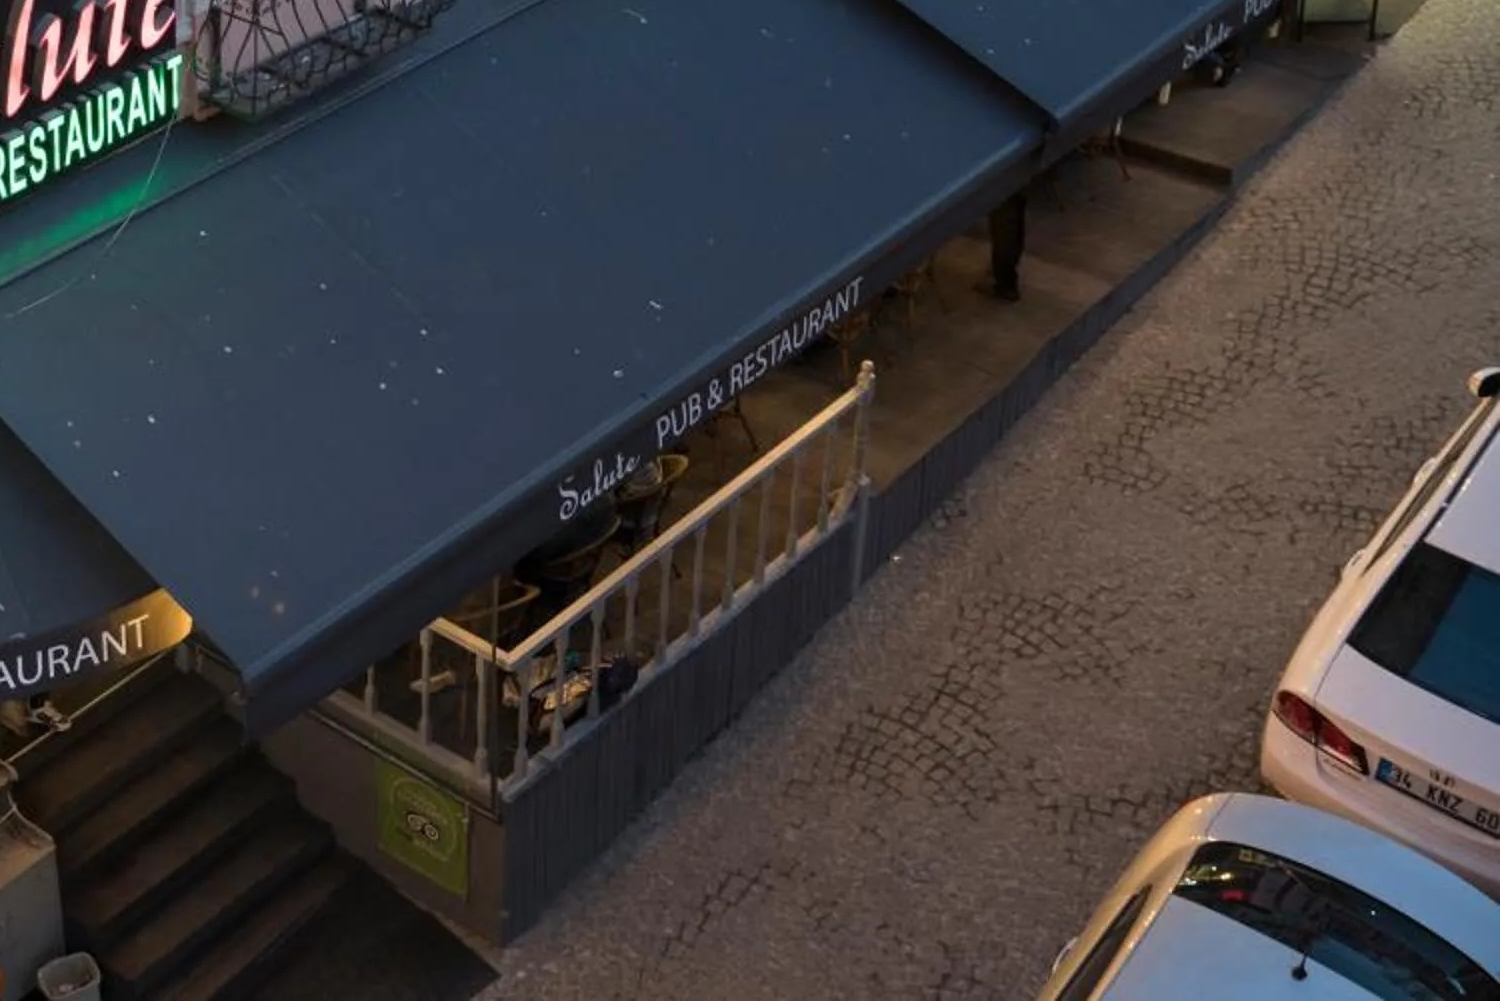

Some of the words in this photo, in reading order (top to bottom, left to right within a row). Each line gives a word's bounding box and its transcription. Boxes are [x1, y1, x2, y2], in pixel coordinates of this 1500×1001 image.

[558, 452, 641, 521] Salute
[655, 392, 702, 450] PUB
[706, 377, 724, 411] &
[728, 276, 864, 395] RESTAURANT
[1426, 783, 1465, 813] KNZ
